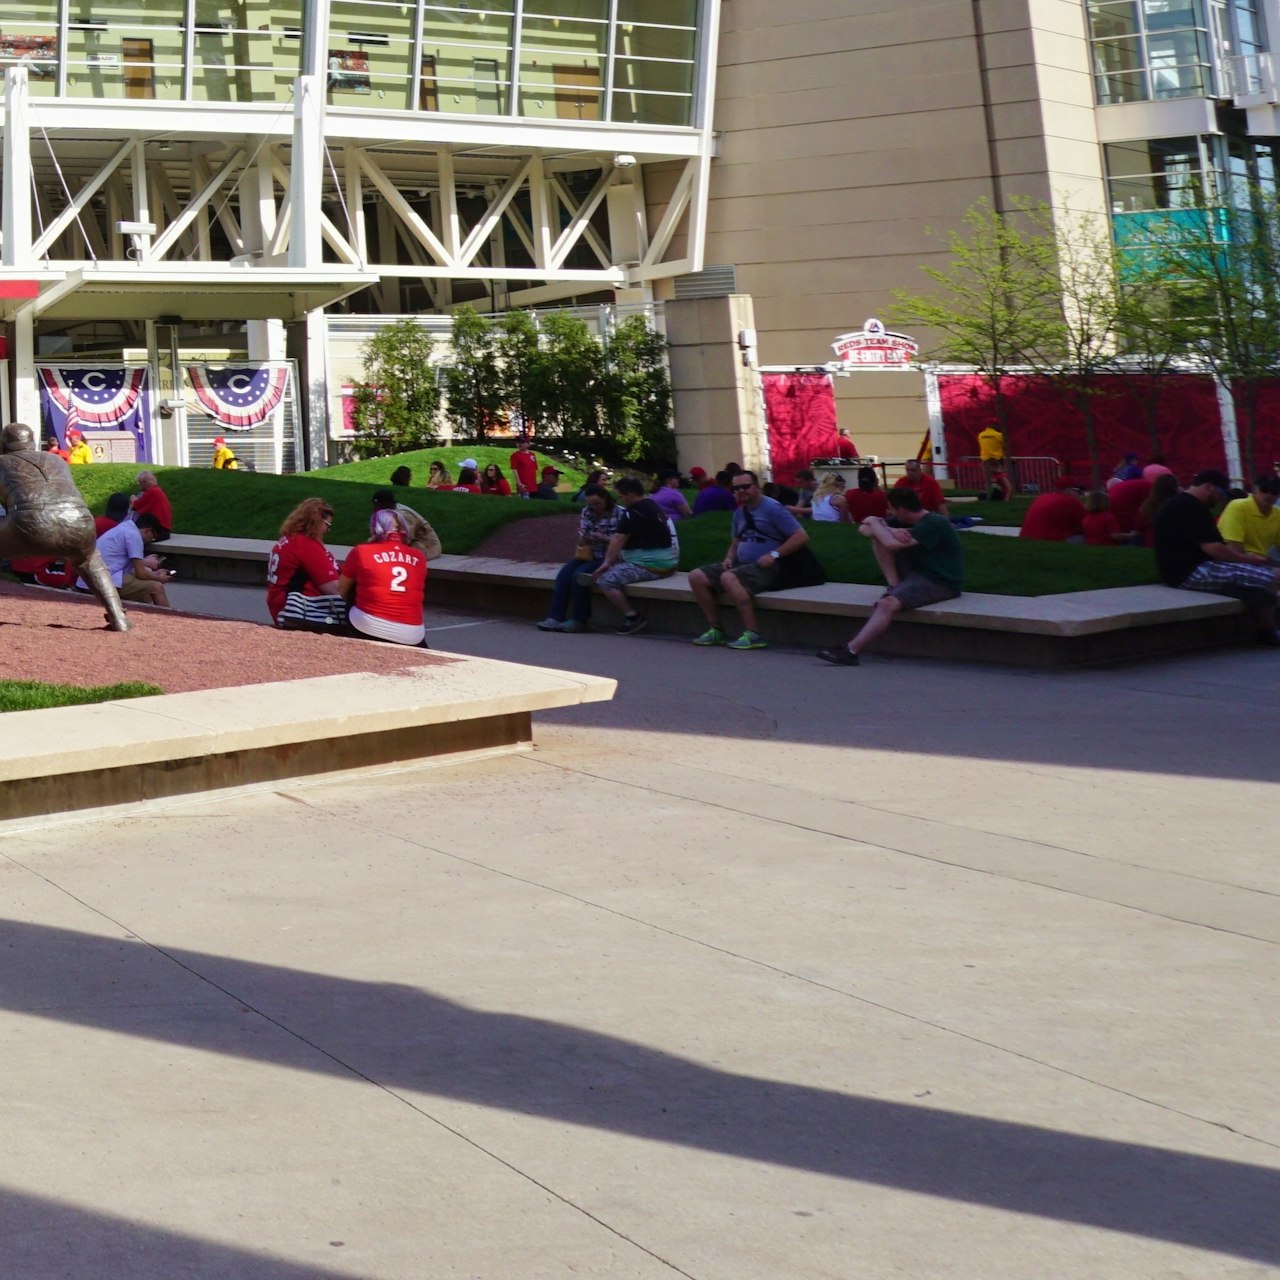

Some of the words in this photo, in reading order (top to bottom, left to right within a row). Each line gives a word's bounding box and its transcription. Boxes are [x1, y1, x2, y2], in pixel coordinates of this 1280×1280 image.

[837, 339, 862, 352] REDS
[864, 337, 889, 345] TEAM
[373, 551, 420, 567] COZART
[390, 566, 408, 593] 2
